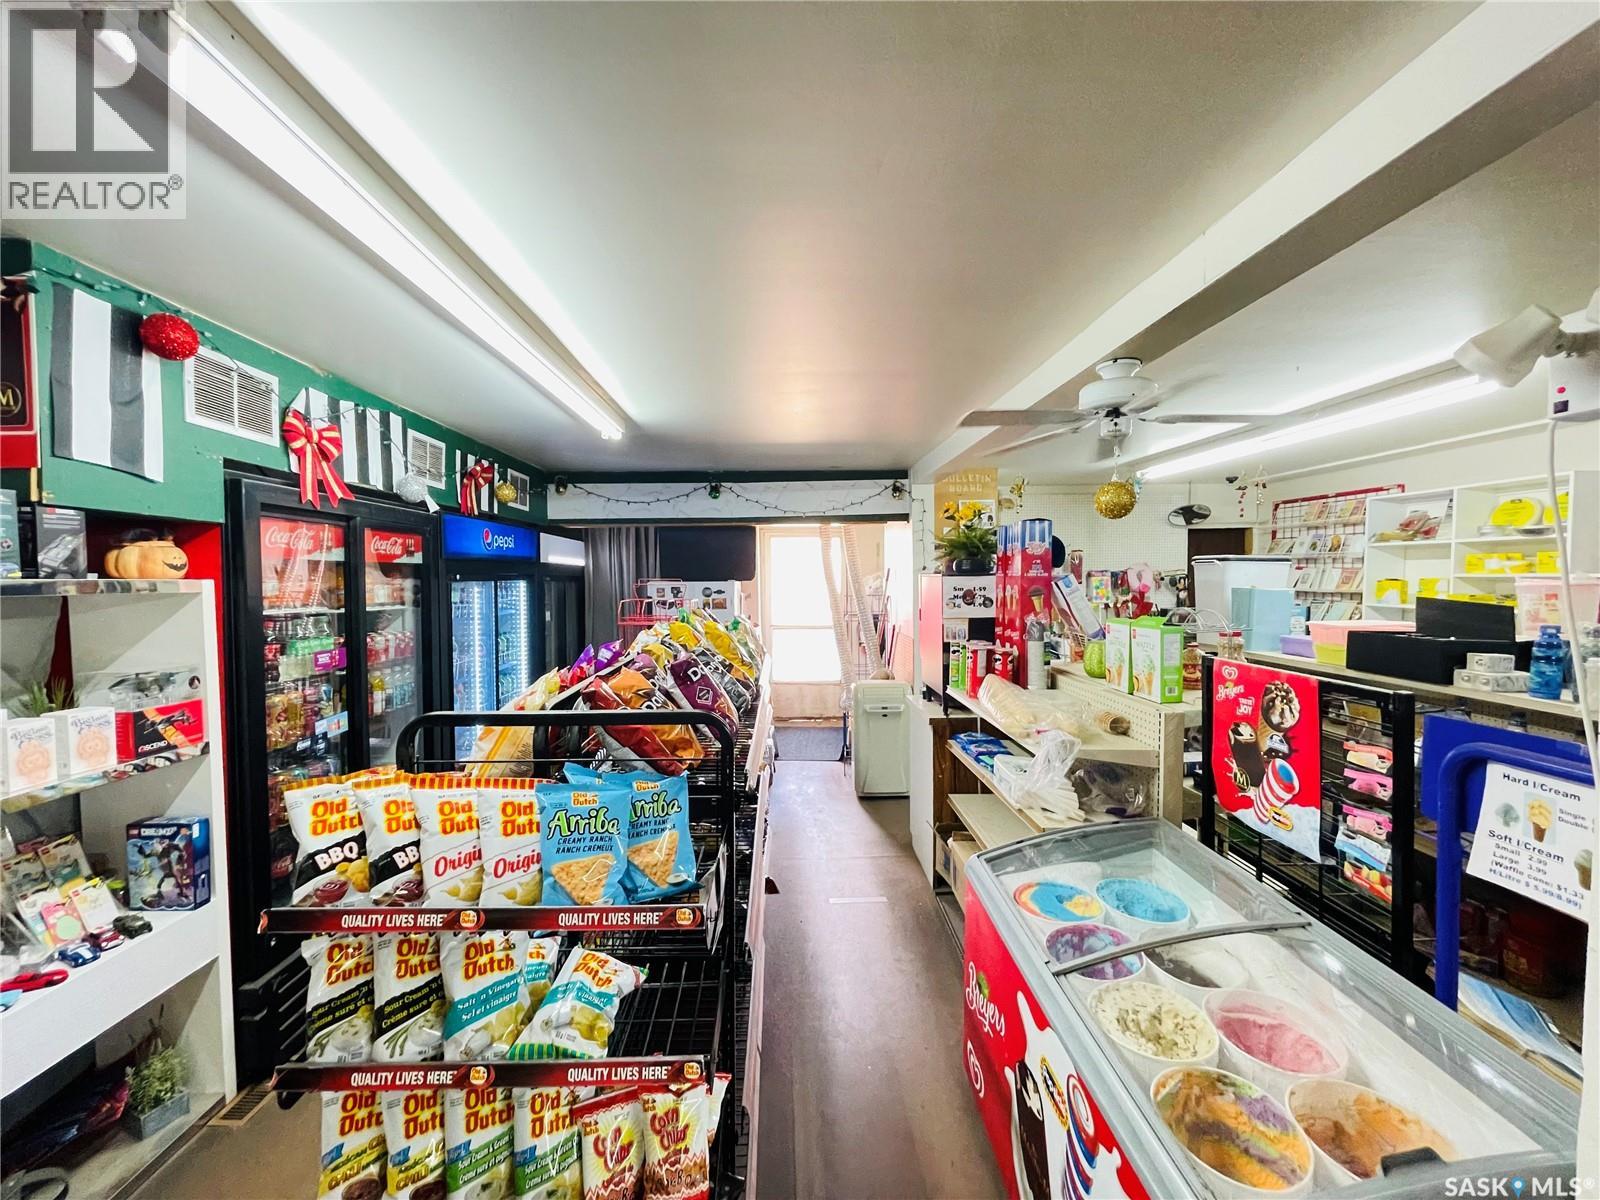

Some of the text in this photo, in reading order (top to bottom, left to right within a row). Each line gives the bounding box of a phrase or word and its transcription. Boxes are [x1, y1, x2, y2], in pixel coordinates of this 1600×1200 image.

[493, 534, 515, 550] pepsi
[1503, 772, 1529, 786] Hard
[311, 798, 348, 818] Old
[438, 800, 473, 816] Old
[501, 801, 534, 817] Old
[547, 806, 620, 840] Arriba
[558, 835, 613, 845] CREAMY RANCH
[1488, 829, 1512, 844] Soft
[314, 841, 359, 872] BBQ
[556, 845, 581, 854] RANCH
[1495, 843, 1520, 856] Small
[341, 914, 384, 928] QUALITY
[386, 914, 415, 927] LIVES
[558, 914, 599, 927] QUALITY
[603, 913, 631, 926] LIVES
[396, 938, 430, 957] Old
[465, 939, 495, 960] Old
[464, 953, 515, 980] Dutch
[582, 952, 609, 970] Old
[573, 962, 613, 989] Dutch
[384, 999, 403, 1014] Sour
[404, 987, 429, 1003] Cream
[965, 961, 1006, 1038] Breyers
[351, 1072, 394, 1086] QUALITY
[395, 1072, 424, 1085] LIVES
[568, 1068, 608, 1082] QUALITY
[611, 1067, 640, 1080] LIVES
[341, 1091, 376, 1113] Old
[403, 1092, 438, 1116] Old
[464, 1088, 498, 1110] Old
[530, 1092, 561, 1115] Old
[650, 1106, 681, 1137] Corn
